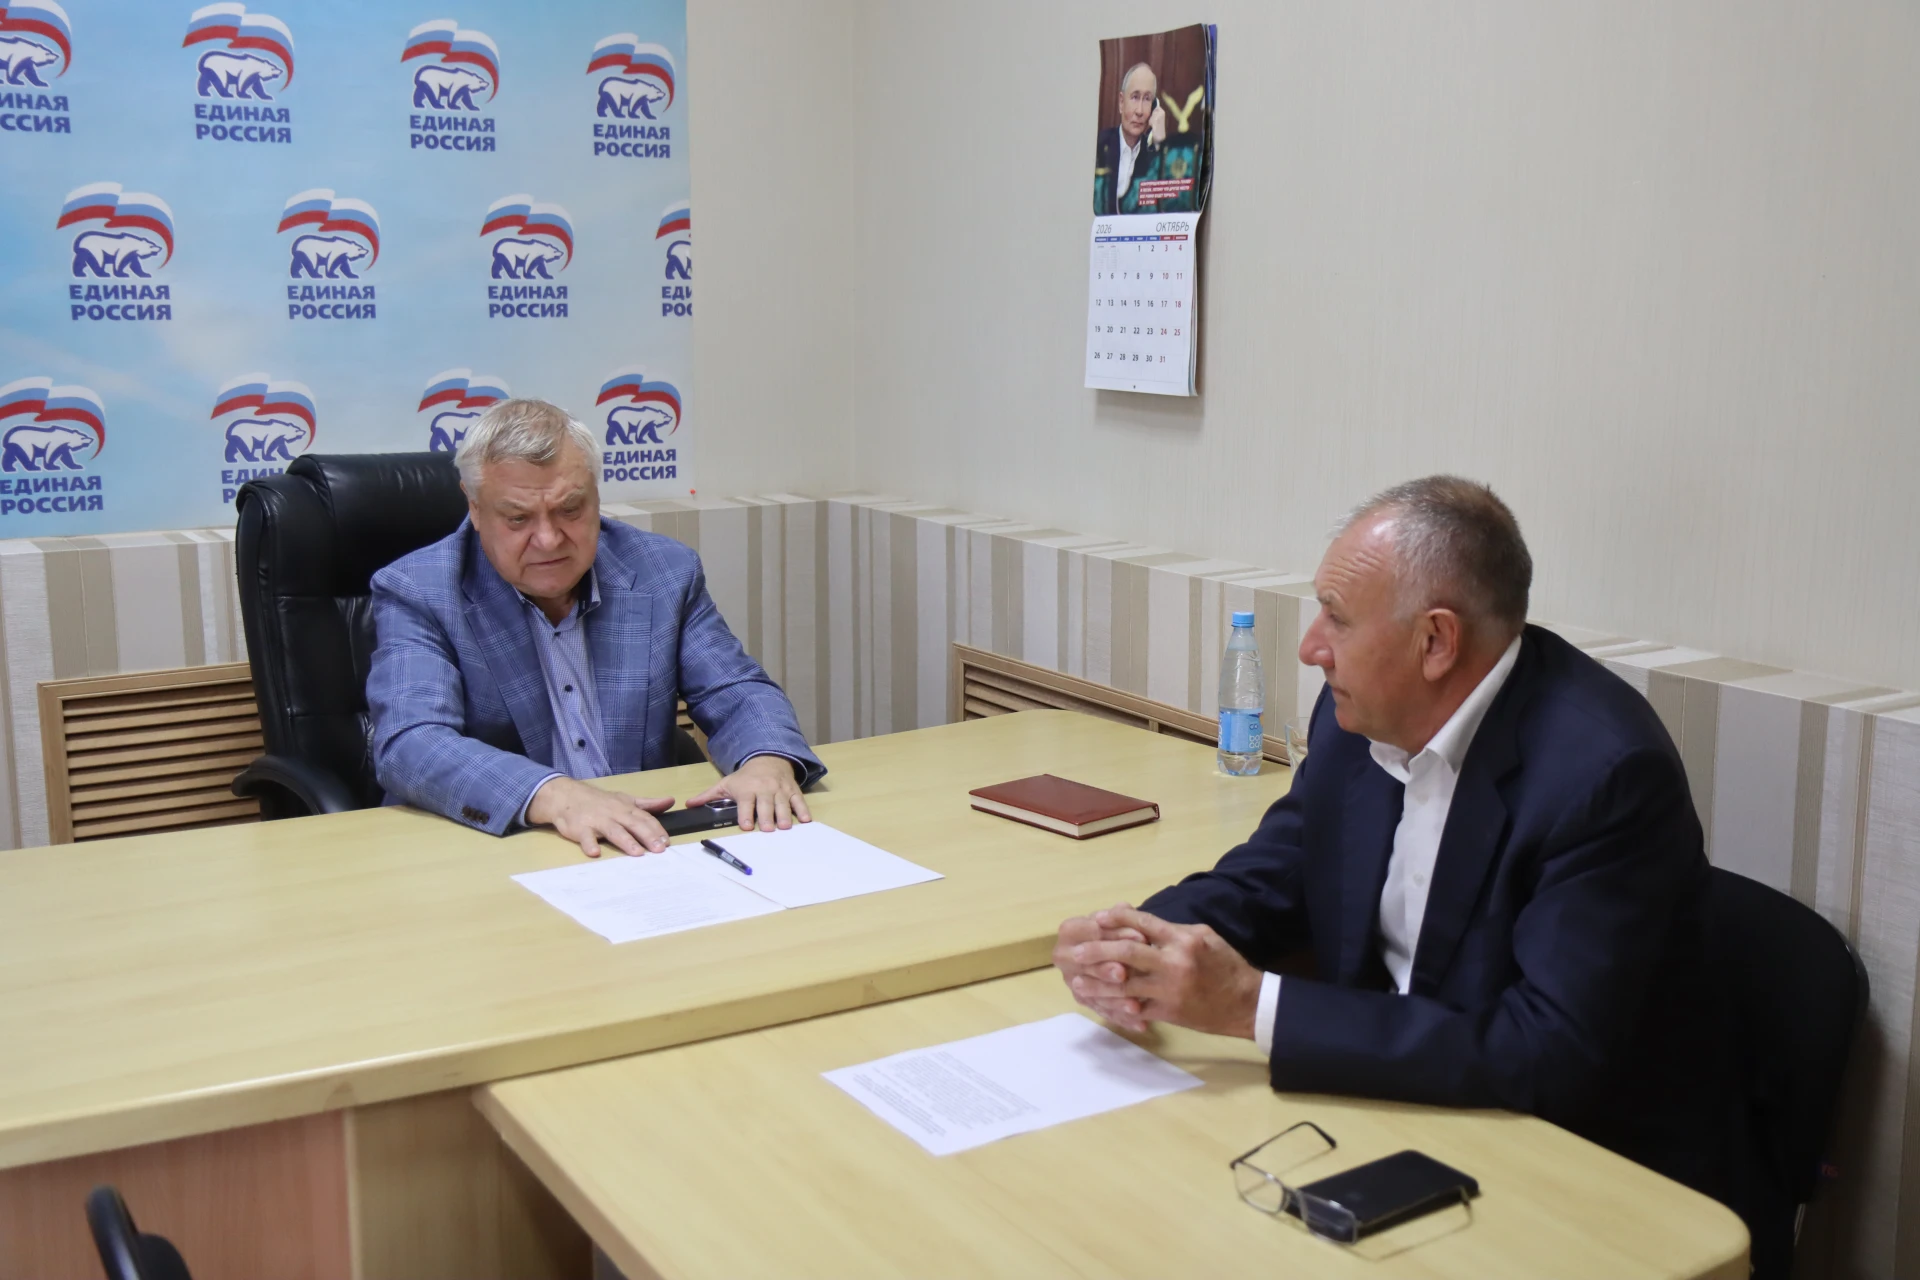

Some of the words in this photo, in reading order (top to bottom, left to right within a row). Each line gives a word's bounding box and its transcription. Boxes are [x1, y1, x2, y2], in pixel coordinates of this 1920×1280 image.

[0, 92, 69, 112] ИНАЯ
[194, 103, 291, 124] ЕДИНАЯ
[0, 113, 72, 134] ССИЯ
[409, 114, 496, 133] ЕДИНАЯ
[593, 123, 671, 141] ЕДИНАЯ
[195, 123, 292, 144] РОССИЯ
[410, 133, 496, 152] РОССИЯ
[593, 141, 671, 159] РОССИЯ
[1095, 224, 1112, 235] 2026
[1155, 222, 1190, 233] ОКТЯБРЬ
[67, 283, 170, 303] ЕДИНАЯ
[286, 285, 376, 302] ЕДИНАЯ
[487, 285, 568, 302] ЕДИНАЯ
[69, 303, 172, 322] РОССИЯ
[288, 303, 377, 320] РОССИЯ
[488, 302, 569, 319] РОССИЯ
[1095, 299, 1102, 307] 12
[1107, 299, 1114, 307] 13
[1133, 300, 1141, 308] 15
[1147, 300, 1154, 308] 16
[1160, 300, 1168, 308] 17
[1174, 301, 1182, 309] 18
[1106, 326, 1114, 334] 20
[1133, 327, 1140, 335] 22
[1160, 328, 1168, 336] 24
[1173, 329, 1181, 337] 25
[1132, 354, 1139, 362] 29
[1145, 355, 1153, 363] 30
[1159, 356, 1166, 364] 31
[602, 448, 677, 467] ЕДИНАЯ
[221, 467, 284, 486] ЕДИН
[603, 464, 677, 483] РОССИЯ
[0, 475, 102, 497] ЕДИНАЯ
[0, 494, 104, 516] РОССИЯ
